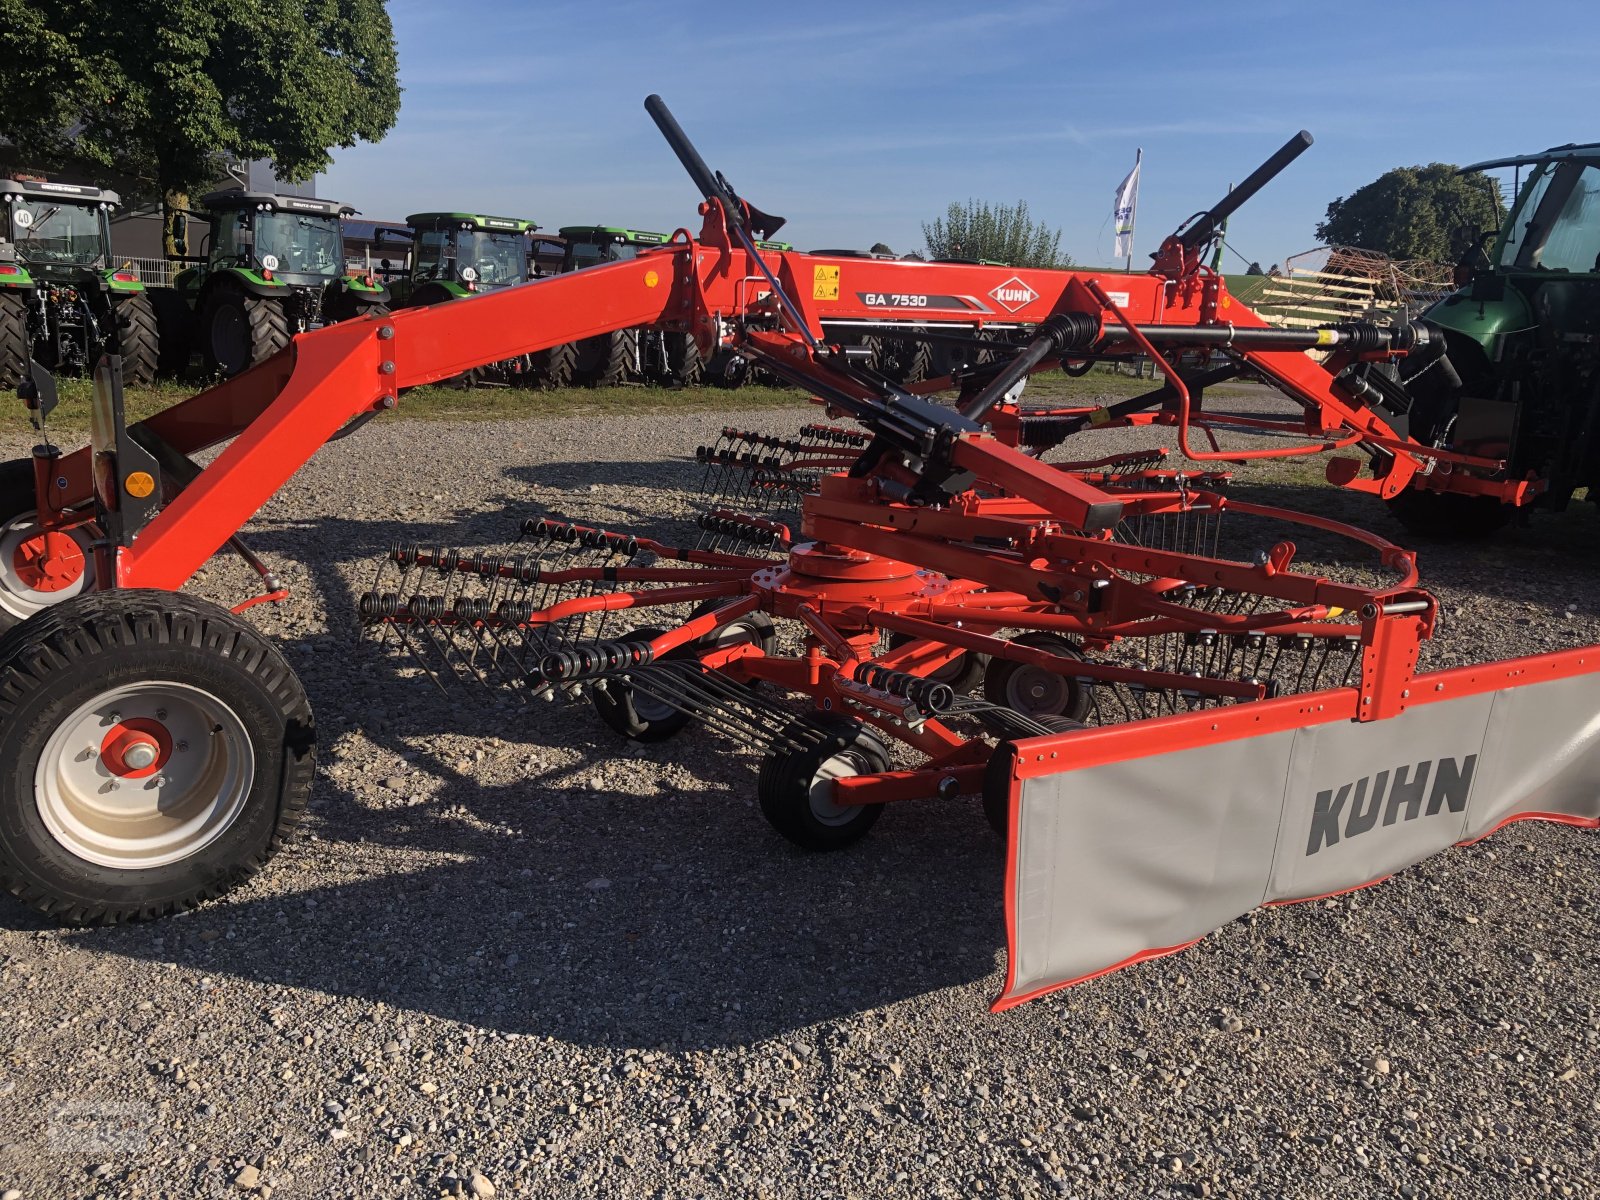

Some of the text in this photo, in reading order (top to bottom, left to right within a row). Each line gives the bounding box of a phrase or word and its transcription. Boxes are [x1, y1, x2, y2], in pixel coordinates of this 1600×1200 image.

[18, 213, 29, 223] 40
[266, 257, 275, 267] 40
[465, 270, 474, 279] 40
[865, 293, 927, 307] GA 7530
[997, 288, 1032, 302] KUHN
[1305, 753, 1478, 857] KUHN
